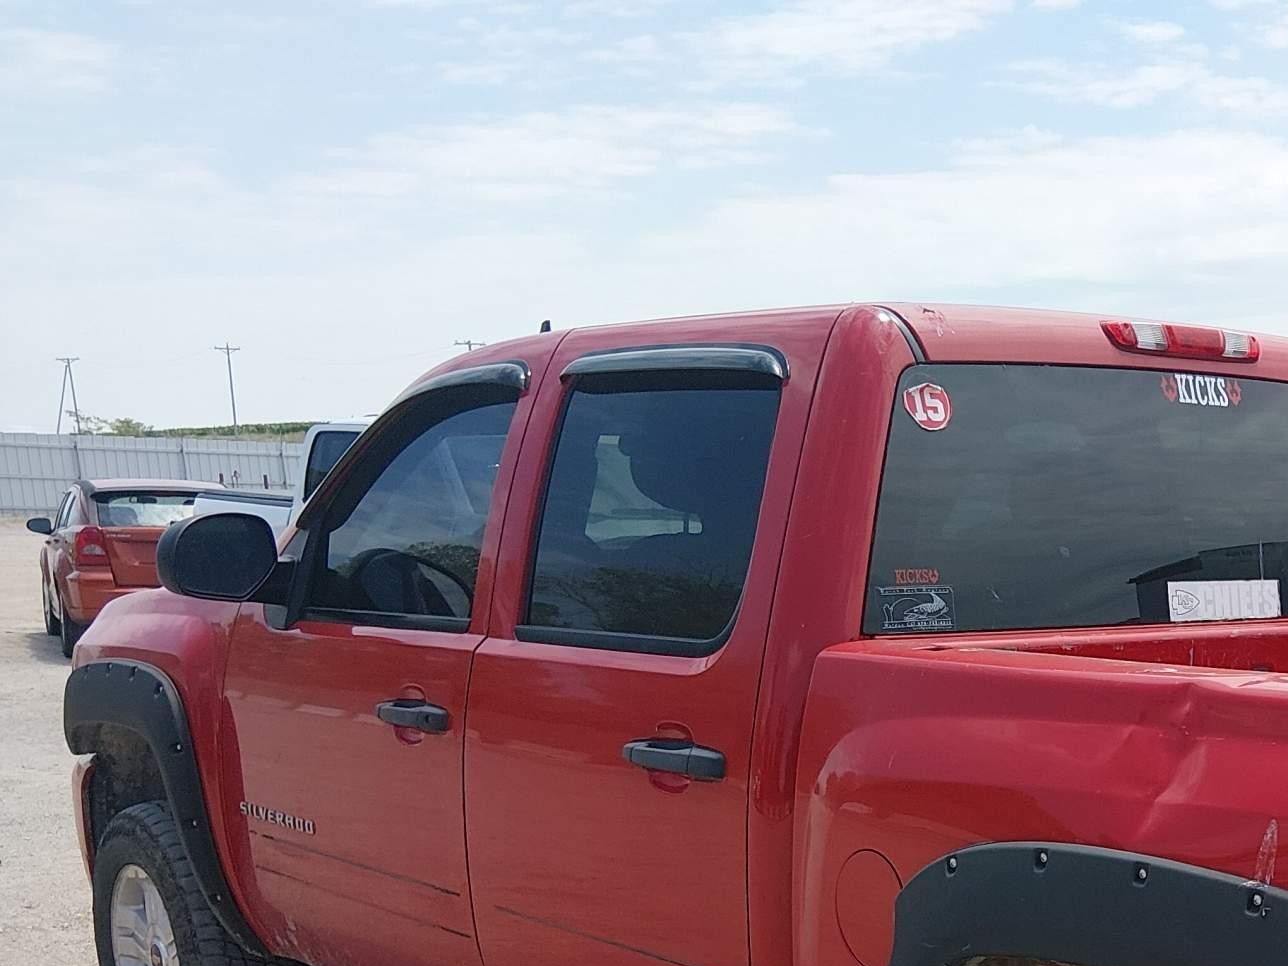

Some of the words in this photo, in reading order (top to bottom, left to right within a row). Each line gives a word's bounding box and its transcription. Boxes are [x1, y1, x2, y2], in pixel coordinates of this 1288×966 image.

[911, 386, 946, 421] 15
[1174, 373, 1229, 407] KICKS
[895, 568, 929, 584] KICKS
[1199, 583, 1278, 618] CHIEFS
[240, 800, 315, 835] SILVERADO
